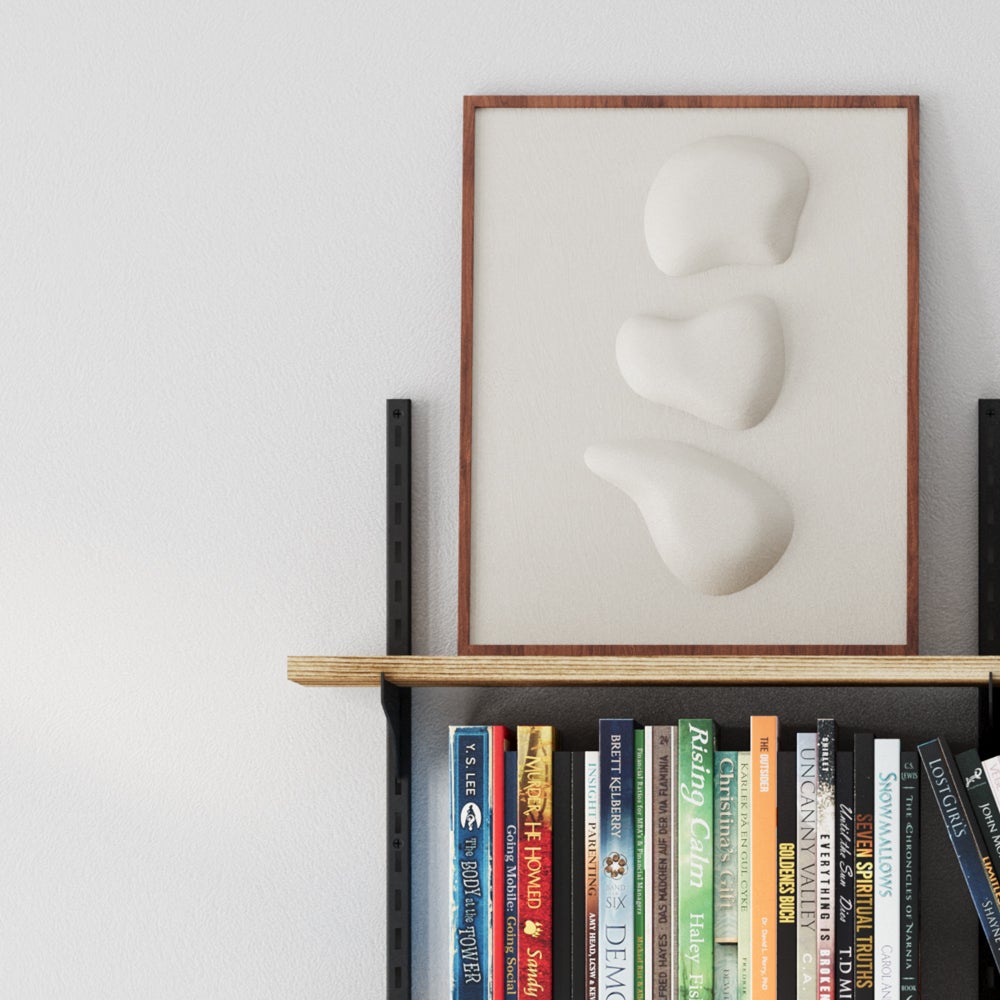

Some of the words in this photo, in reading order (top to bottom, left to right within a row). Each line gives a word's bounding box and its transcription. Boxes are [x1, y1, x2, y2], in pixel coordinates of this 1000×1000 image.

[465, 743, 476, 753] Y.
[465, 757, 476, 768] S.
[610, 734, 621, 774] BRETT
[760, 737, 769, 752] THE
[680, 723, 710, 807] Rising
[760, 753, 769, 793] OUTSIDER
[901, 771, 918, 781] LEWIS
[465, 773, 476, 796] LEE
[588, 763, 597, 818] INSIGHT
[800, 747, 815, 856] UNCANNY
[608, 776, 621, 839] KELBERRY
[658, 799, 668, 815] VIA
[719, 757, 735, 863] Christina's
[839, 804, 853, 840] Until
[905, 795, 913, 818] THE
[979, 802, 999, 834] JOHN
[506, 824, 517, 862] Going
[523, 822, 542, 841] HE
[658, 817, 668, 834] DER
[855, 814, 873, 858] SEVEN
[878, 772, 897, 898] SNOWMALLOWS
[465, 838, 477, 857] The
[588, 822, 597, 897] PARENTING
[689, 817, 710, 888] Calm
[839, 838, 853, 858] the
[905, 822, 913, 901] CHRONICLES
[460, 860, 482, 897] BODY
[523, 847, 542, 909] HOWLED
[779, 843, 795, 894] GOLDENES
[820, 834, 831, 920] EVERYTHING
[839, 860, 853, 887] Sun
[465, 898, 477, 907] at
[506, 865, 517, 912] Mobile:
[606, 895, 627, 909] SIX
[719, 870, 735, 911] Gift
[800, 863, 815, 932] VALLEY
[855, 861, 873, 932] SPIRITUAL
[465, 908, 477, 924] the
[588, 912, 596, 932] AMY
[658, 904, 668, 924] DAS
[779, 895, 795, 923] BUCH
[839, 895, 853, 923] Dies
[905, 905, 913, 918] OF
[504, 915, 516, 954] Going
[588, 932, 596, 957] HEAD,
[658, 934, 668, 967] HAYES
[686, 913, 704, 963] Haley
[820, 928, 831, 941] IS
[905, 922, 913, 970] NARNIA
[457, 926, 482, 984] TOWER
[523, 947, 544, 997] Sandy
[855, 935, 873, 989] TRUTHS
[880, 944, 893, 979] CAROL
[506, 957, 517, 995] Social
